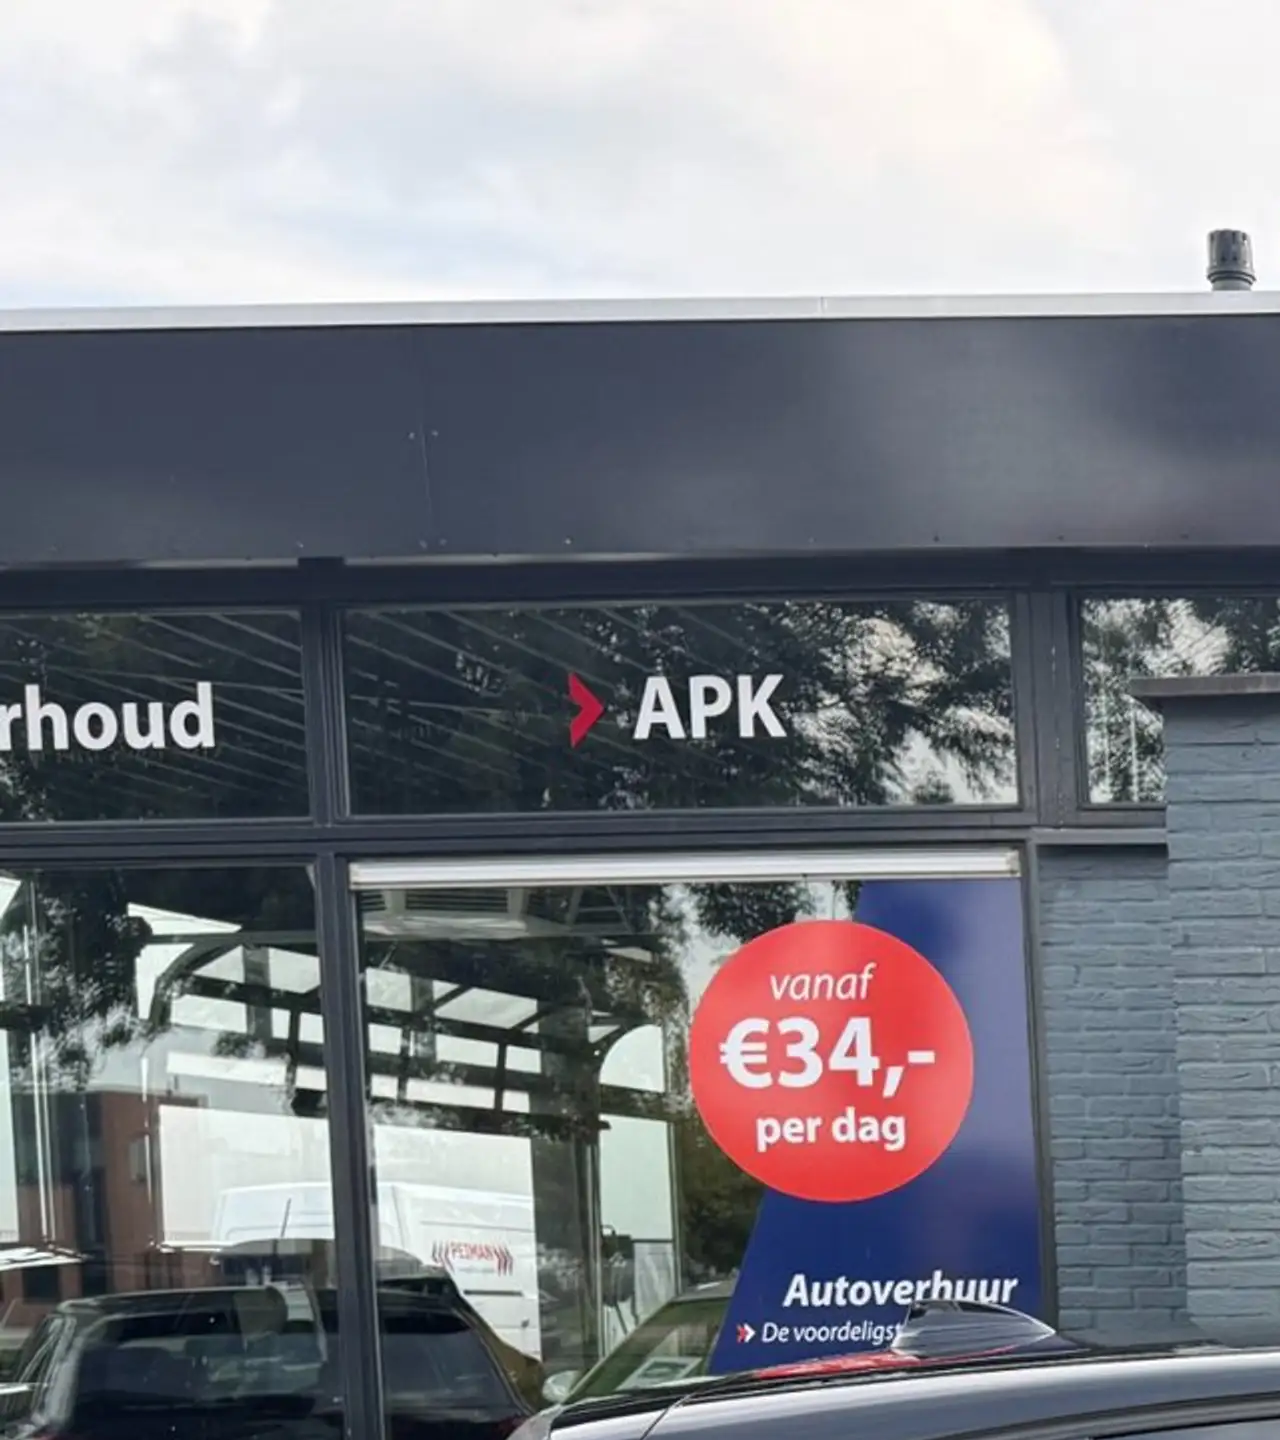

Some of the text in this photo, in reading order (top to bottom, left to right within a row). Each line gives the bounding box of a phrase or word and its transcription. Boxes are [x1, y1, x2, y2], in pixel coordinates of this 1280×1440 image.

[633, 673, 788, 740] APK
[770, 962, 876, 1001] vanaf
[718, 1015, 937, 1098] €34,-
[756, 1107, 906, 1153] per dag
[782, 1270, 1019, 1308] Autoverhuur
[762, 1322, 788, 1343] De
